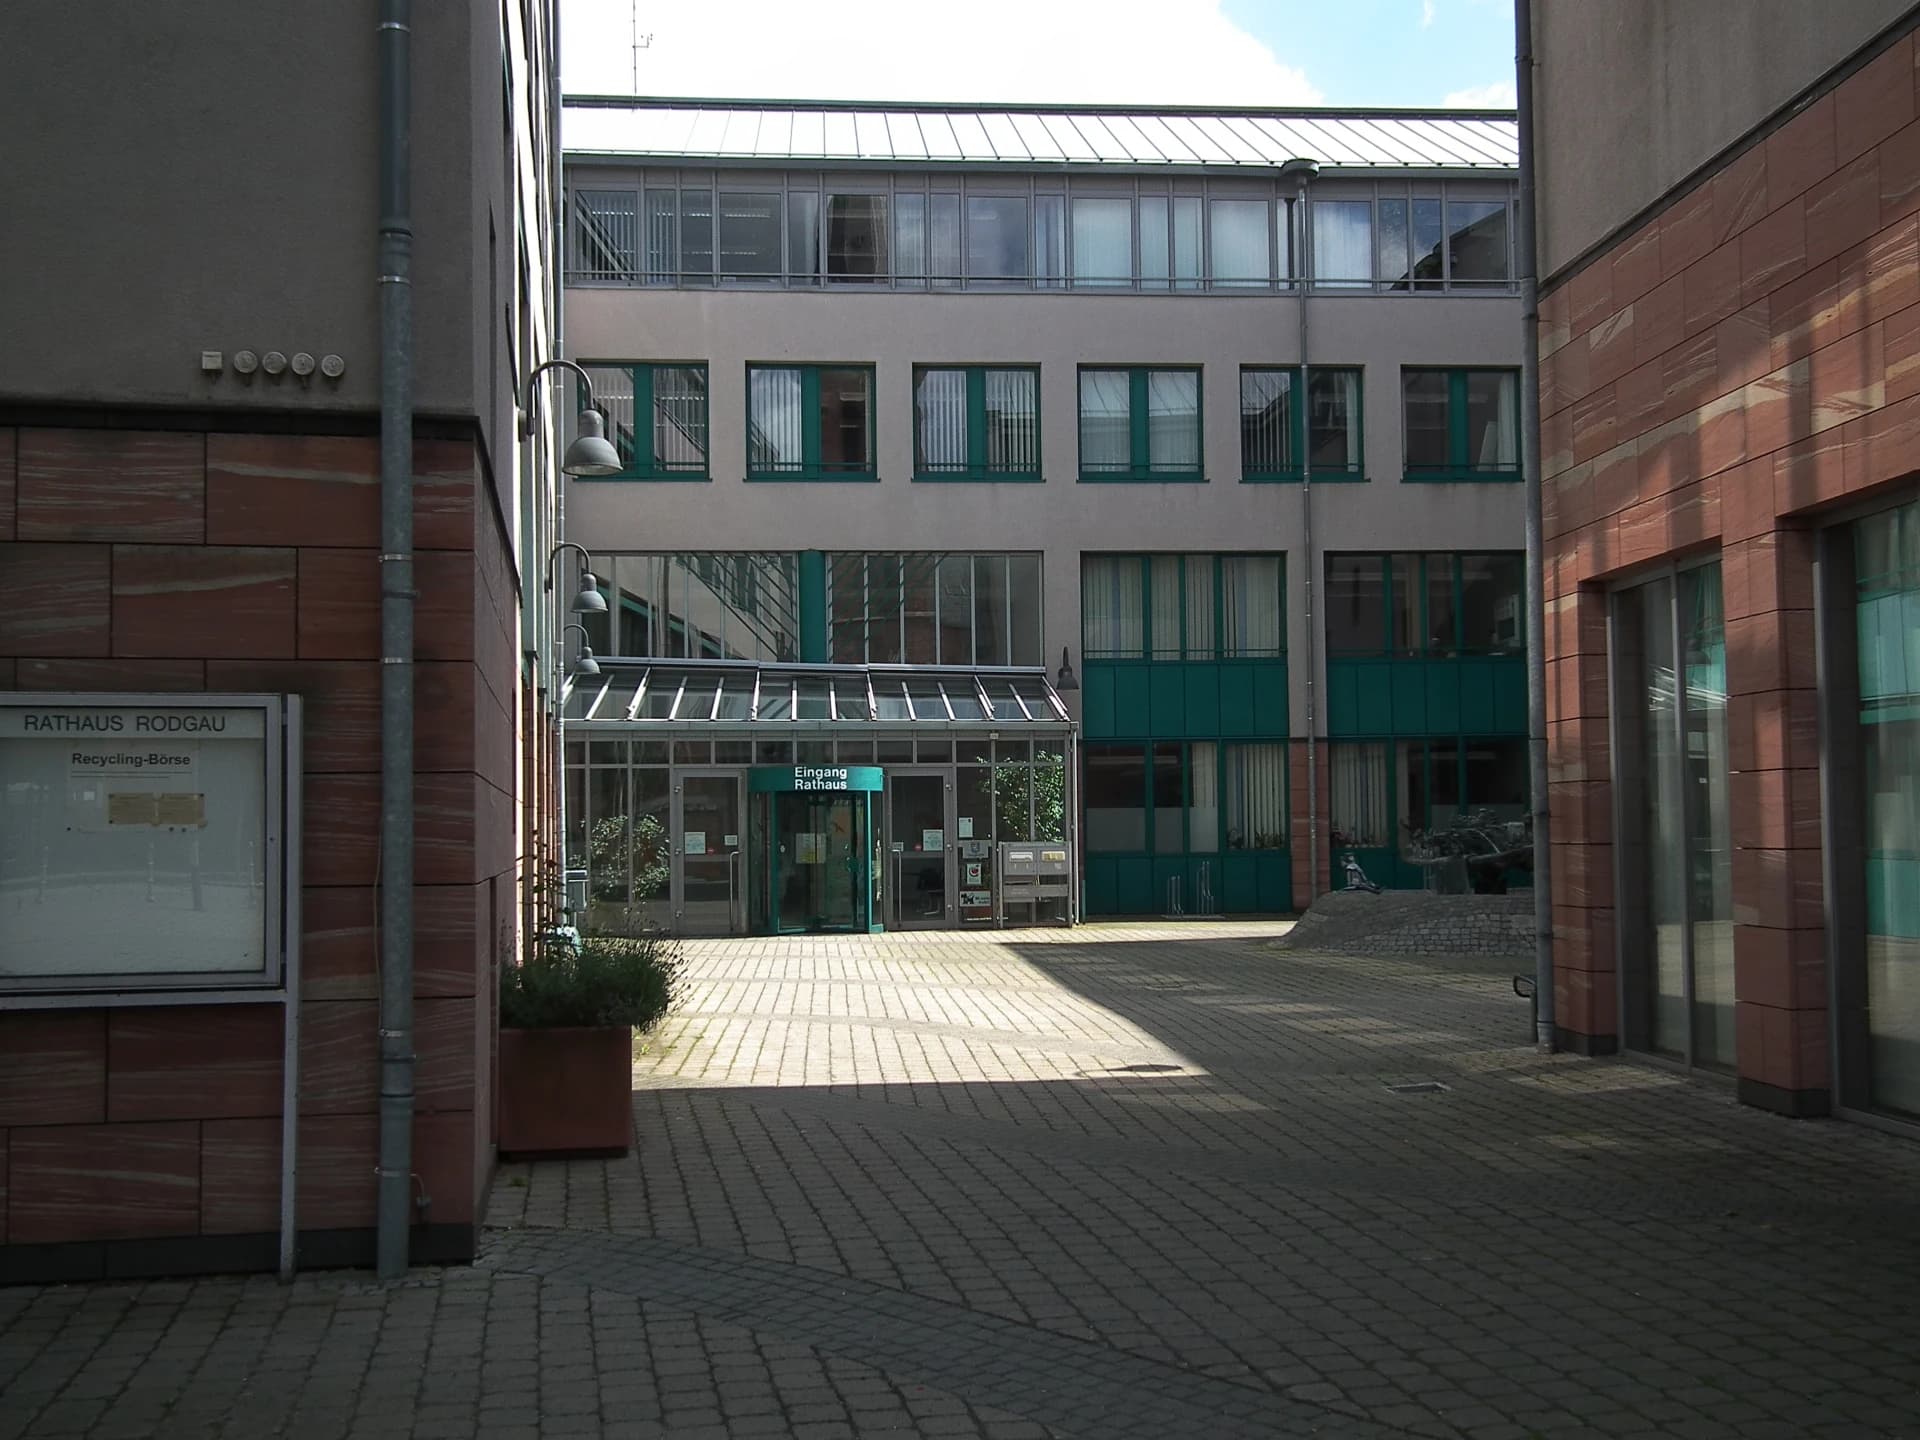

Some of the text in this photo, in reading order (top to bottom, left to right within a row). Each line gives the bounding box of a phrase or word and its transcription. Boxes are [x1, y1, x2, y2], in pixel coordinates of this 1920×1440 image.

[24, 714, 226, 732] RATHAUS RODGAU
[72, 752, 191, 767] Recycling-Börse
[794, 766, 848, 780] Eingang
[794, 778, 848, 790] Rathaus
